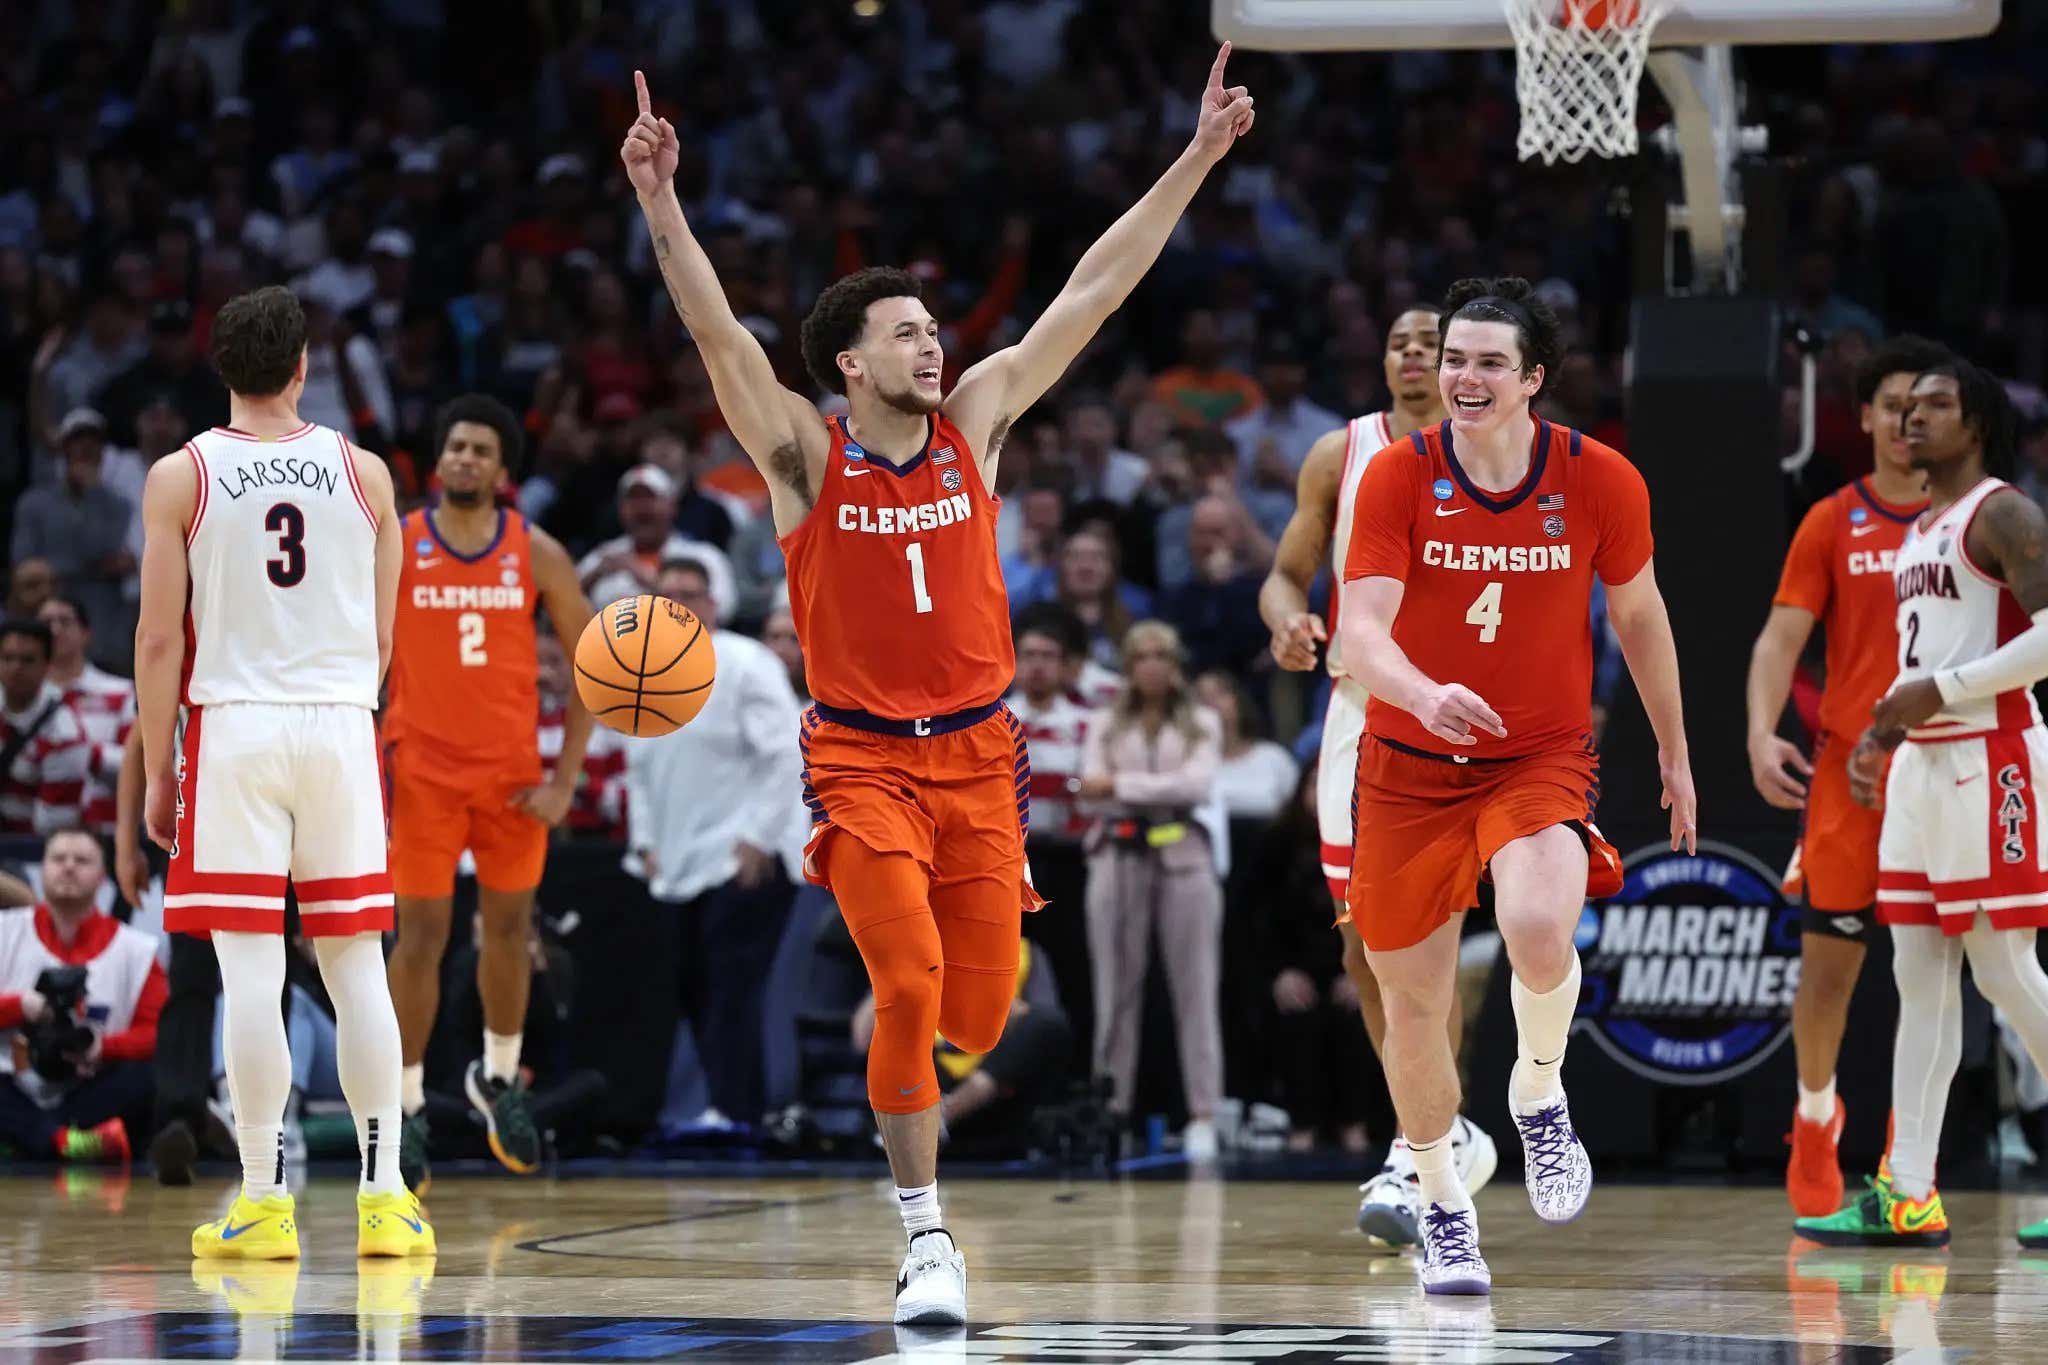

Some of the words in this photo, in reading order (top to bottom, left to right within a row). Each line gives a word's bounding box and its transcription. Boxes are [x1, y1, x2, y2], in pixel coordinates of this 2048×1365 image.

[218, 458, 338, 500] LARSSON
[838, 491, 972, 534] CLEMSON
[265, 502, 306, 588] 3
[1422, 540, 1571, 572] CLEMSON
[1848, 549, 1898, 576] CLE
[413, 585, 525, 610] CLEMSON
[906, 542, 933, 613] 1
[1465, 582, 1503, 643] 4
[458, 612, 488, 667] 2
[1906, 611, 1919, 668] 2
[915, 717, 930, 736] C
[1998, 764, 2028, 863] CATS
[1601, 905, 1770, 955] MARCH
[1617, 955, 1802, 1005] MADNES
